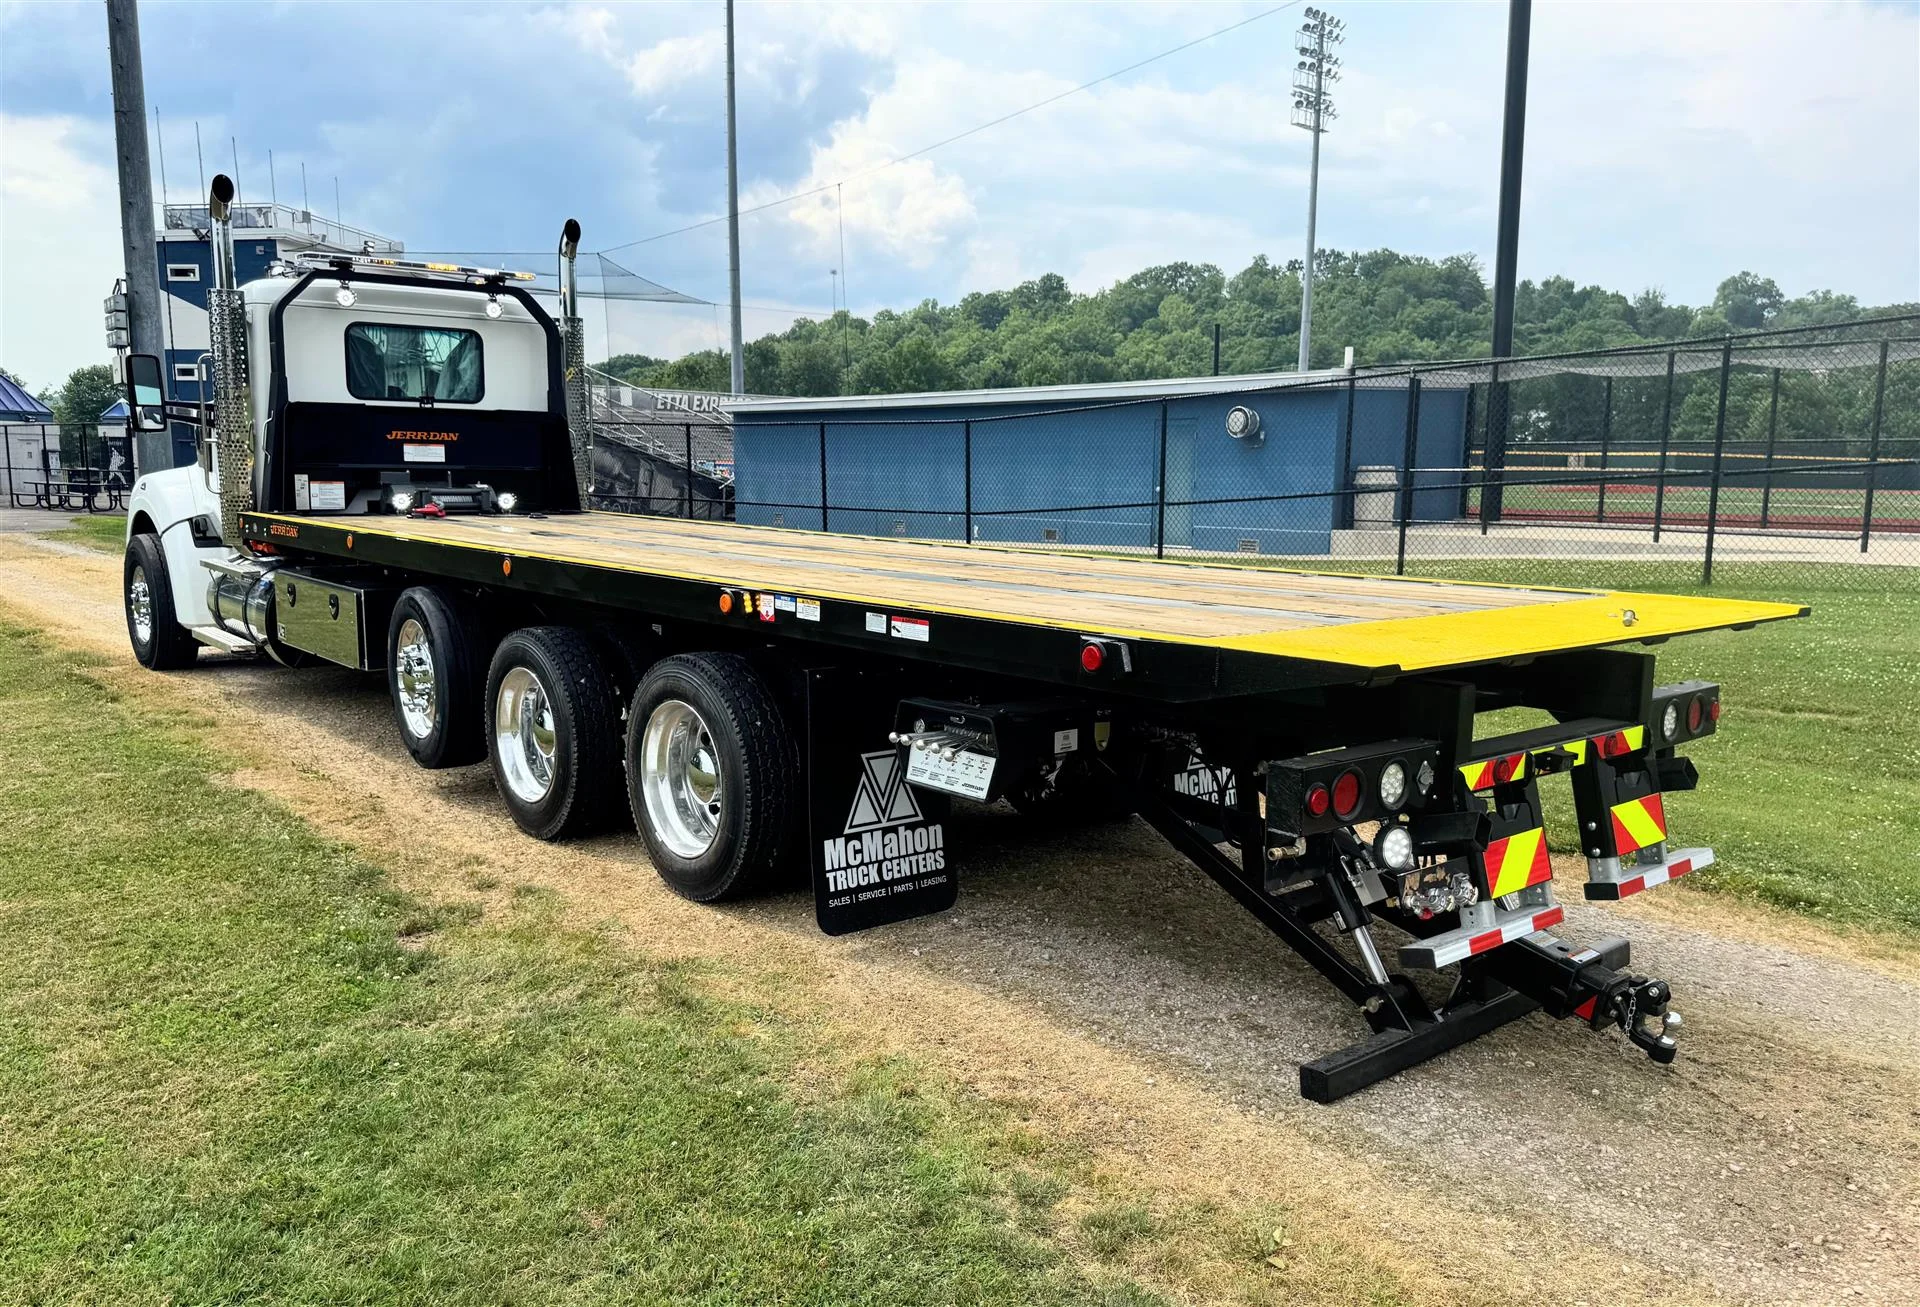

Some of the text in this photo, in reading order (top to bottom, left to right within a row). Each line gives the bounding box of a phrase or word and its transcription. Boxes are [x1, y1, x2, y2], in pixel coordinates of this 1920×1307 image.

[823, 824, 944, 871] McMahon
[825, 850, 946, 893] TRUCK CENTERS
[828, 875, 947, 908] SALES SERVICE PARTS LEASING
